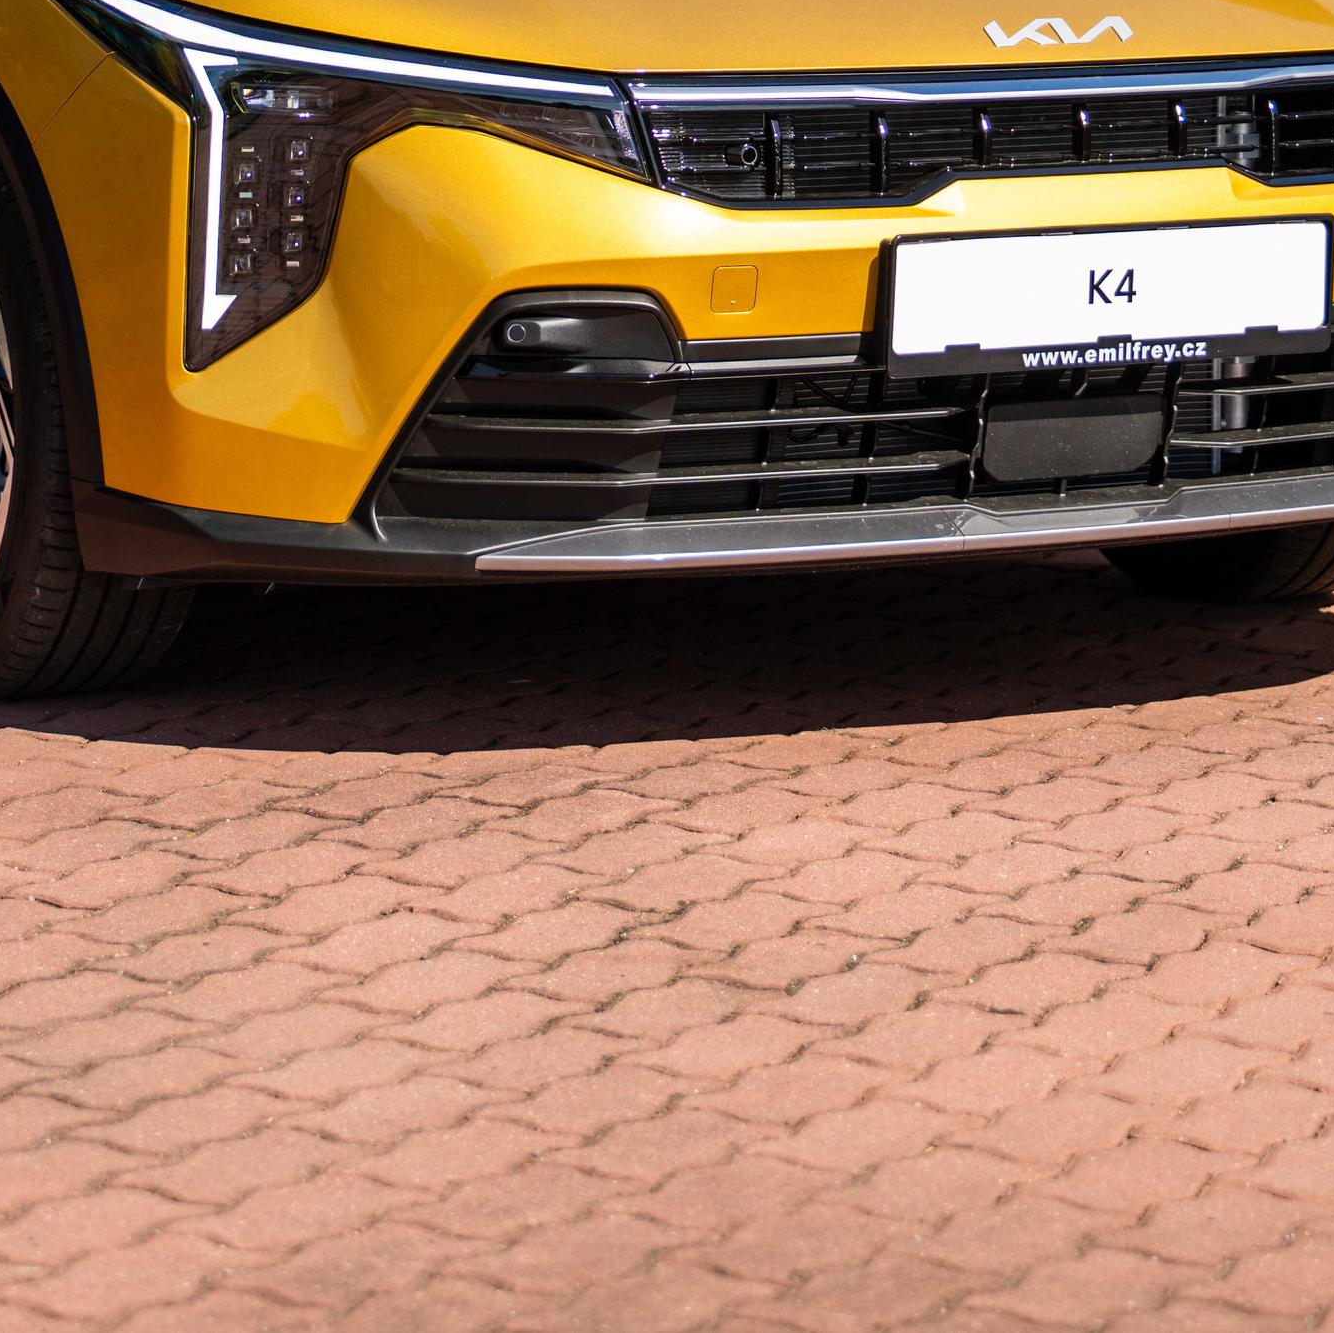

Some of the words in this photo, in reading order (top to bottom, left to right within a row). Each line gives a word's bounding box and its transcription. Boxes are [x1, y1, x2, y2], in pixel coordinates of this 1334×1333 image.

[984, 15, 1134, 48] KIA
[1088, 268, 1136, 304] K4
[1022, 341, 1207, 367] www.emilfrey.cz
